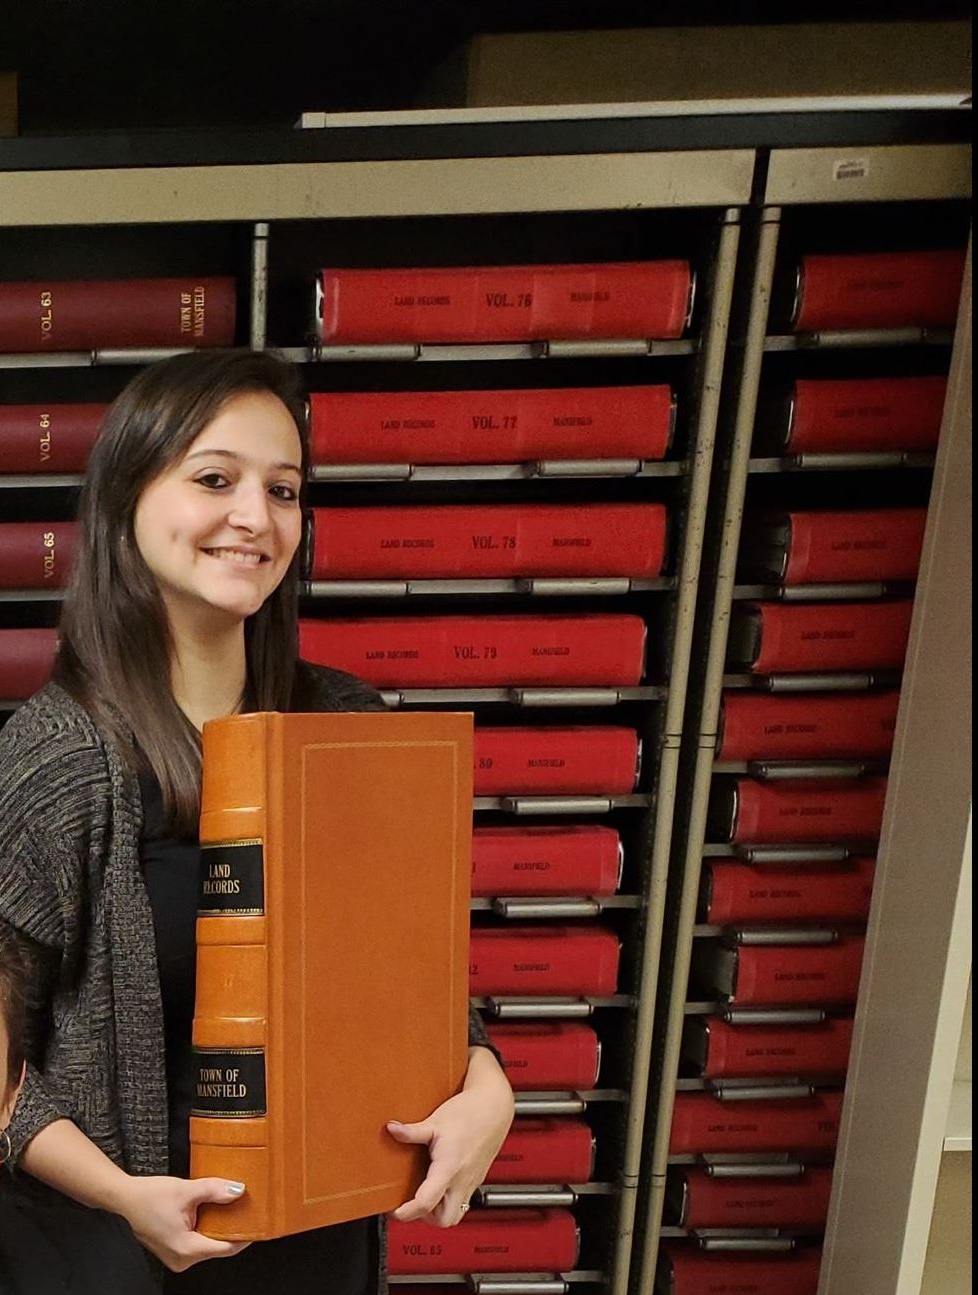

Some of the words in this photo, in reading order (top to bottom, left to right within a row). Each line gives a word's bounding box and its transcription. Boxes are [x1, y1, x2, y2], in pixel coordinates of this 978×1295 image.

[40, 291, 52, 308] 63
[181, 292, 192, 305] OF
[486, 294, 514, 308] VOL.
[194, 286, 206, 337] MANSFIELD
[40, 310, 52, 341] VOL.
[181, 308, 192, 333] TOWN
[40, 412, 50, 429] 64
[381, 420, 401, 430] LAND
[472, 416, 500, 430] VOL.
[502, 416, 518, 430] 77
[40, 432, 52, 462] VOL.
[44, 532, 54, 548] 65
[380, 539, 400, 548] LAND
[472, 536, 499, 550] VOL.
[502, 536, 516, 548] 78
[44, 550, 56, 578] VOL.
[366, 650, 386, 660] LAND
[454, 646, 481, 660] VOL.
[483, 646, 497, 660] 79
[209, 864, 231, 880] LAND
[203, 879, 240, 895] RECORDS
[199, 1068, 224, 1082] TOWN
[226, 1068, 240, 1082] OF
[197, 1082, 247, 1098] MANSFIELD
[403, 1246, 428, 1256] VOL.
